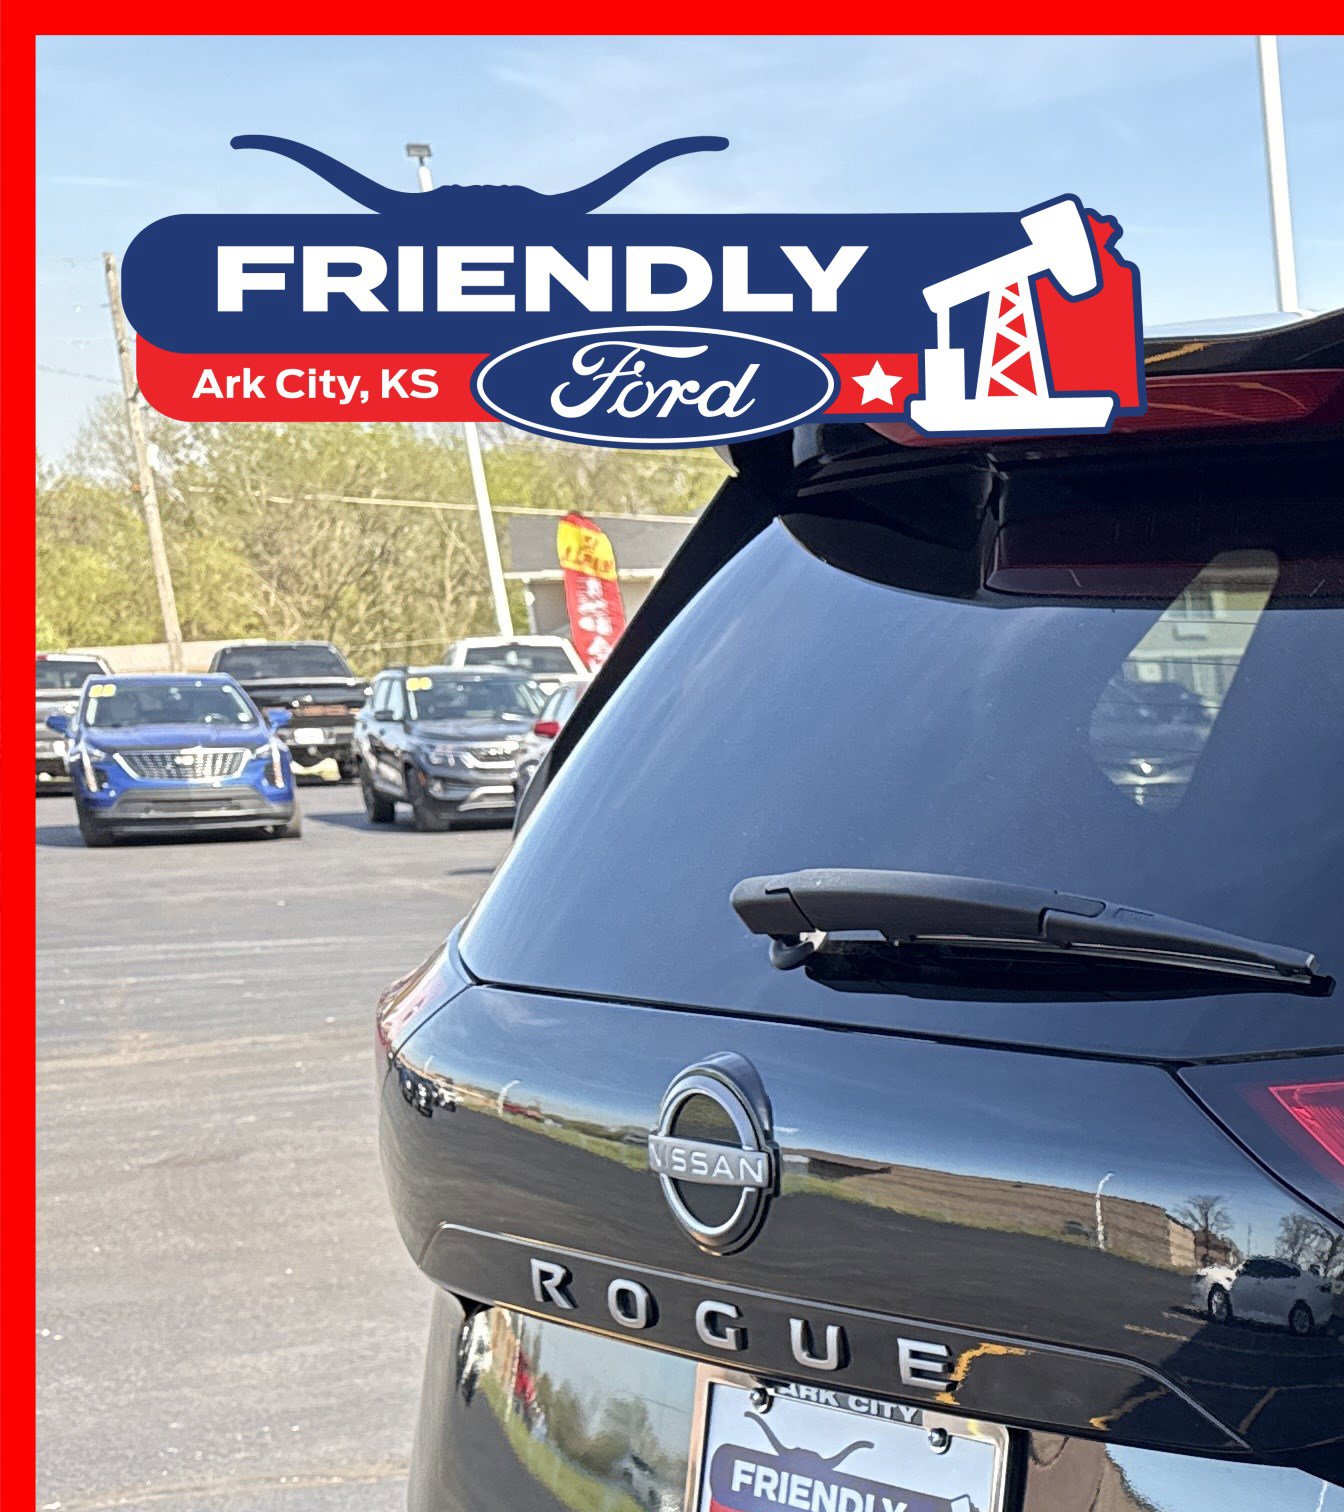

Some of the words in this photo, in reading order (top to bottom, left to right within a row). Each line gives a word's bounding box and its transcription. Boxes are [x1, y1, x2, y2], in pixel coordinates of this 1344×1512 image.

[650, 1143, 764, 1183] NISSAN
[530, 1258, 958, 1391] ROGUE
[848, 1395, 919, 1423] CITY
